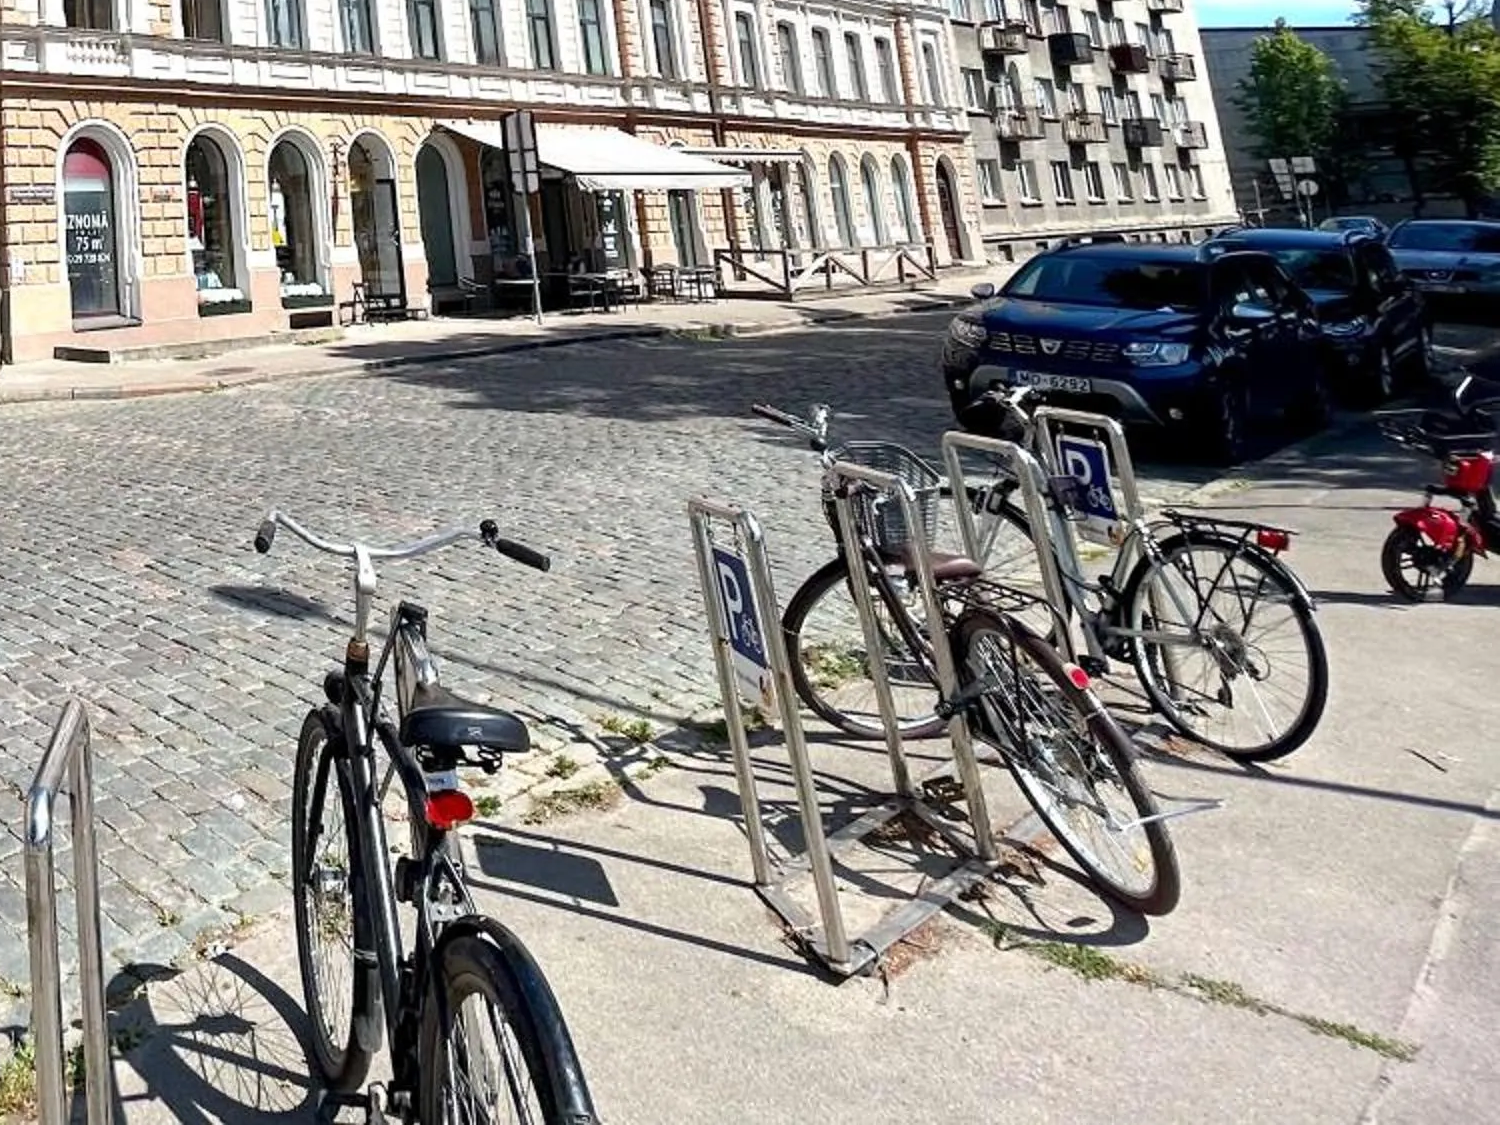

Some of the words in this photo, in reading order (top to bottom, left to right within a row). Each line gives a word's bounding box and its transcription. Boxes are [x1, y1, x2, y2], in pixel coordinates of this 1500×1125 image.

[76, 236, 89, 251] 75
[1065, 448, 1093, 486] P
[718, 562, 743, 641] P
